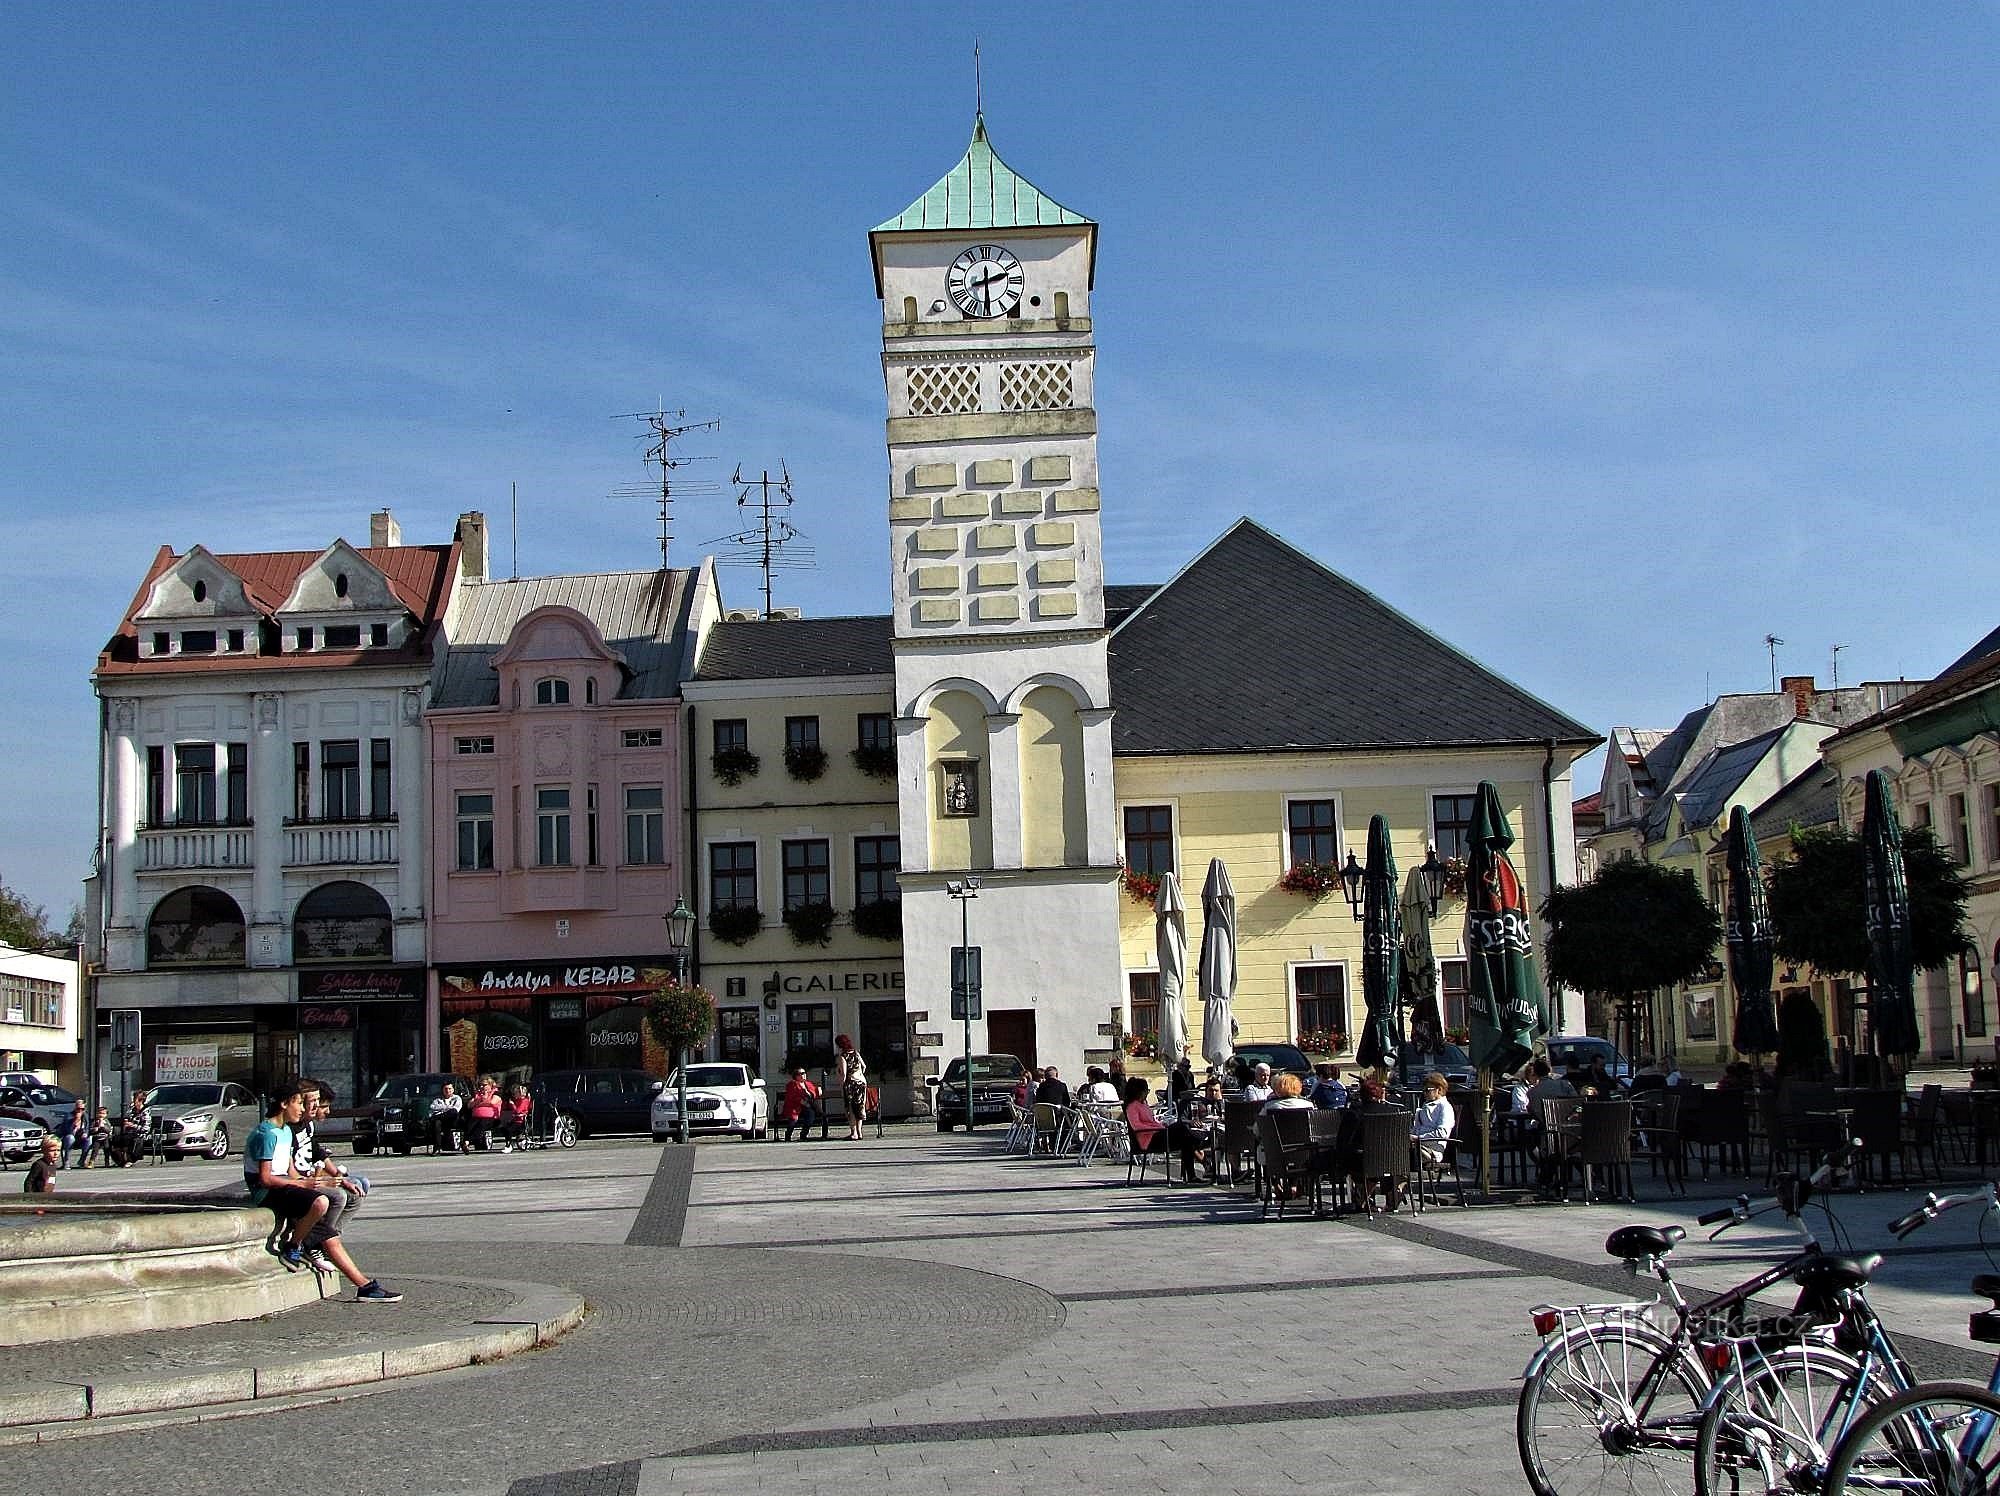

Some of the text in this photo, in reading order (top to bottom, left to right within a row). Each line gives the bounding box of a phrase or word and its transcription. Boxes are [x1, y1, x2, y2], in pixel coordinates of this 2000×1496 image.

[980, 247, 991, 259] XII
[481, 966, 636, 992] Antalya KEBAB
[783, 972, 905, 992] GALERIE
[484, 1035, 529, 1049] KEBAB
[158, 1056, 216, 1068] NA PRODEJ
